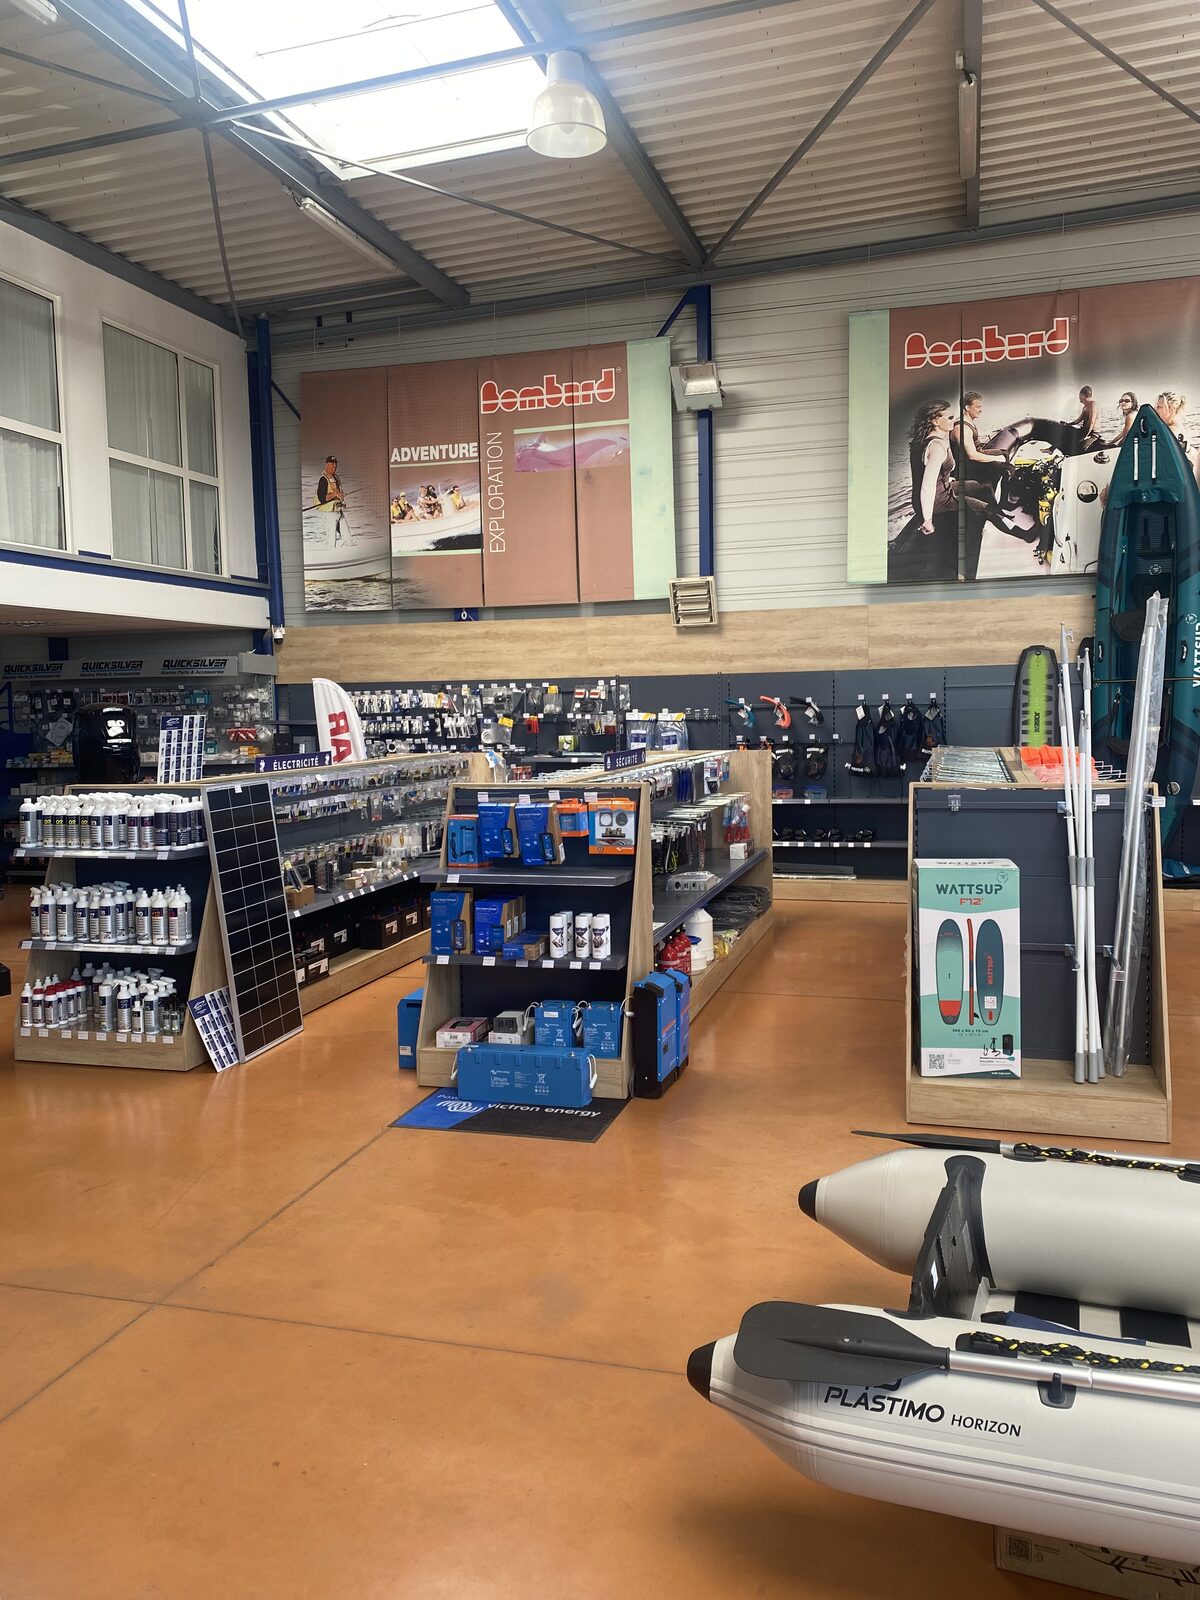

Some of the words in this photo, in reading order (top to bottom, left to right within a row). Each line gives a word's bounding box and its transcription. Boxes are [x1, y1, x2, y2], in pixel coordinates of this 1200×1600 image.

[390, 442, 478, 462] ADVENTURE
[487, 431, 506, 553] EXPLORATION
[4, 663, 64, 674] QUICKSILVER
[81, 661, 143, 672] QUICKSILVER
[162, 659, 228, 670] QUICKSILVER
[273, 756, 319, 771] ÉLECTRICITÉ
[616, 752, 638, 767] SÉCURITÉ
[936, 884, 1003, 895] WATTSUP
[487, 1102, 540, 1112] victron
[544, 1107, 601, 1118] energy
[824, 1386, 945, 1423] PLASTIMO
[951, 1414, 1021, 1437] HORIZON
